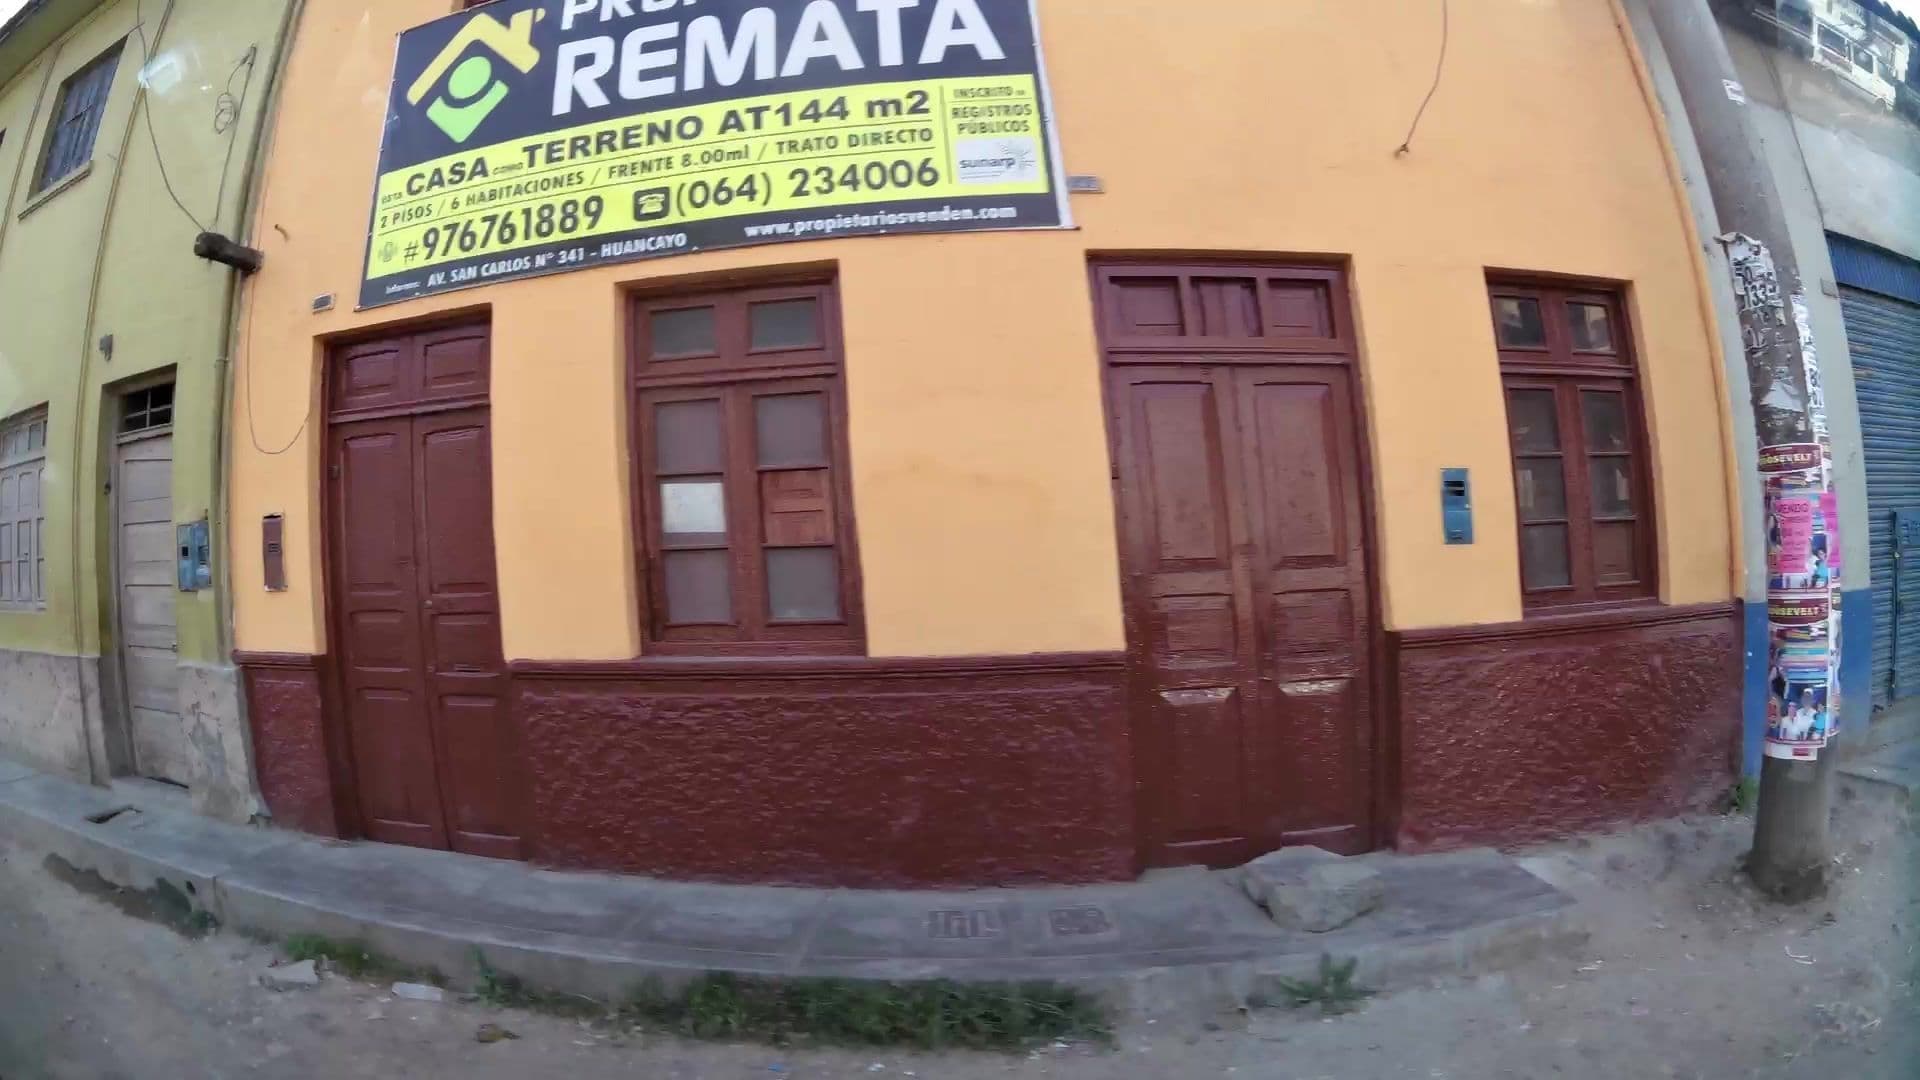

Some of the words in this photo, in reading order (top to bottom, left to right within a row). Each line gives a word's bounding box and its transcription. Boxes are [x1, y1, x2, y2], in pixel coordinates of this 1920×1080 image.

[552, 0, 1006, 116] REMATA
[951, 104, 1032, 119] REGISTROS
[406, 157, 489, 196] CASA
[522, 115, 704, 168] TERRENO
[718, 96, 849, 135] AT144
[866, 90, 930, 118] m2
[381, 215, 388, 229] 2
[392, 203, 433, 225] PISOS
[451, 196, 460, 210] 6
[465, 170, 585, 206] HABITACIONES
[608, 156, 673, 179] FRENTE
[776, 135, 838, 155] TRATO
[848, 127, 934, 148] DIRECTO
[677, 171, 772, 217] (064)
[789, 157, 940, 198] 234006
[744, 205, 1018, 237] www.propietariosvenden.com
[427, 271, 447, 287] AV.
[450, 265, 478, 282] SAN
[481, 255, 531, 276] CARLOS
[558, 247, 585, 264] 341
[601, 232, 688, 258] HUANCAYO
